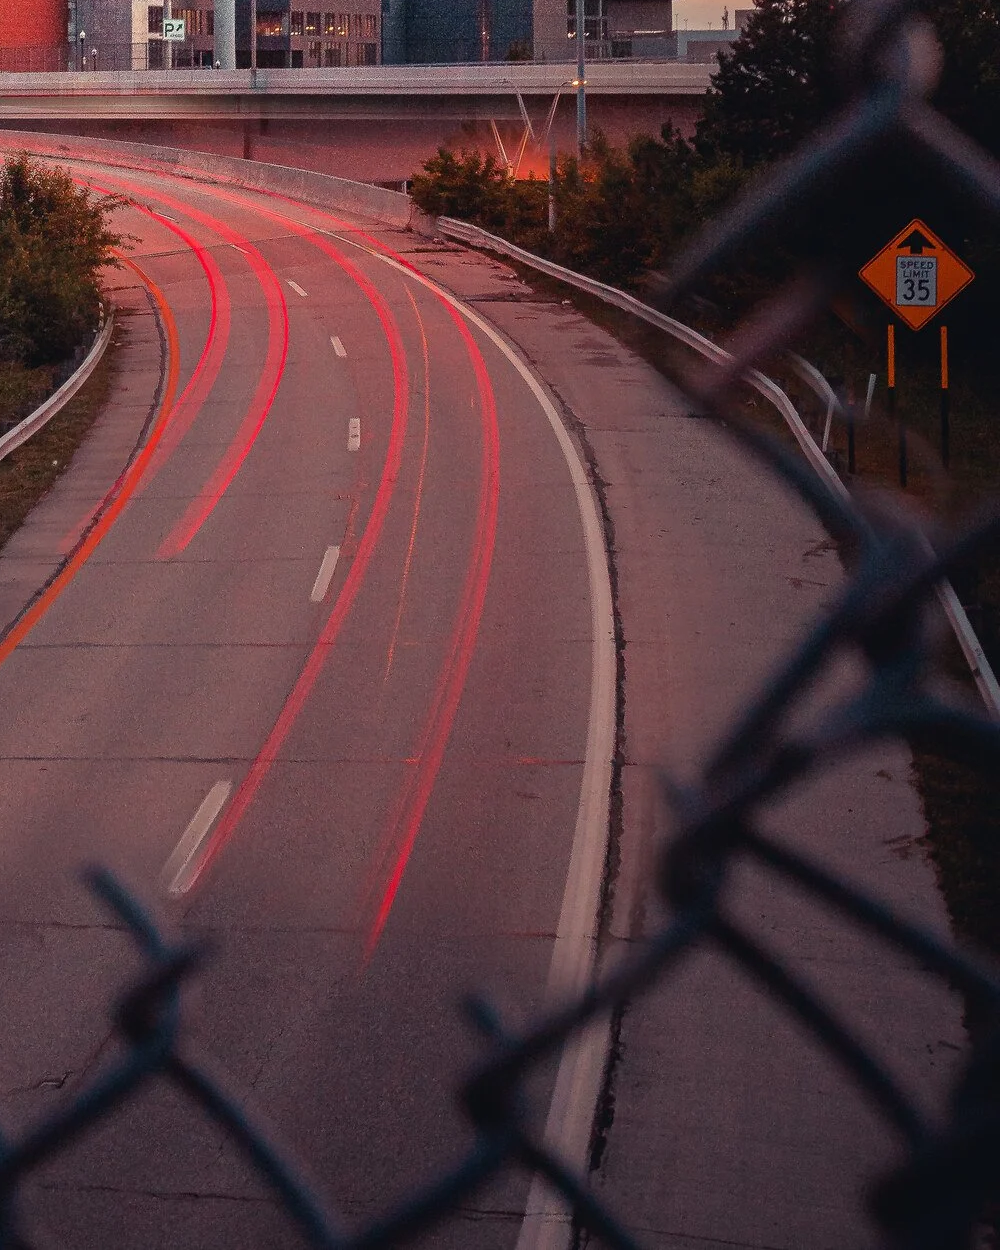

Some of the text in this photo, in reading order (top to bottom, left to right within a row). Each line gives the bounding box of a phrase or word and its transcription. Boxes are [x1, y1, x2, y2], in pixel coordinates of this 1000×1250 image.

[165, 23, 174, 37] P
[900, 261, 934, 269] SPEED
[903, 270, 930, 278] LIMIT
[903, 279, 930, 301] 35
